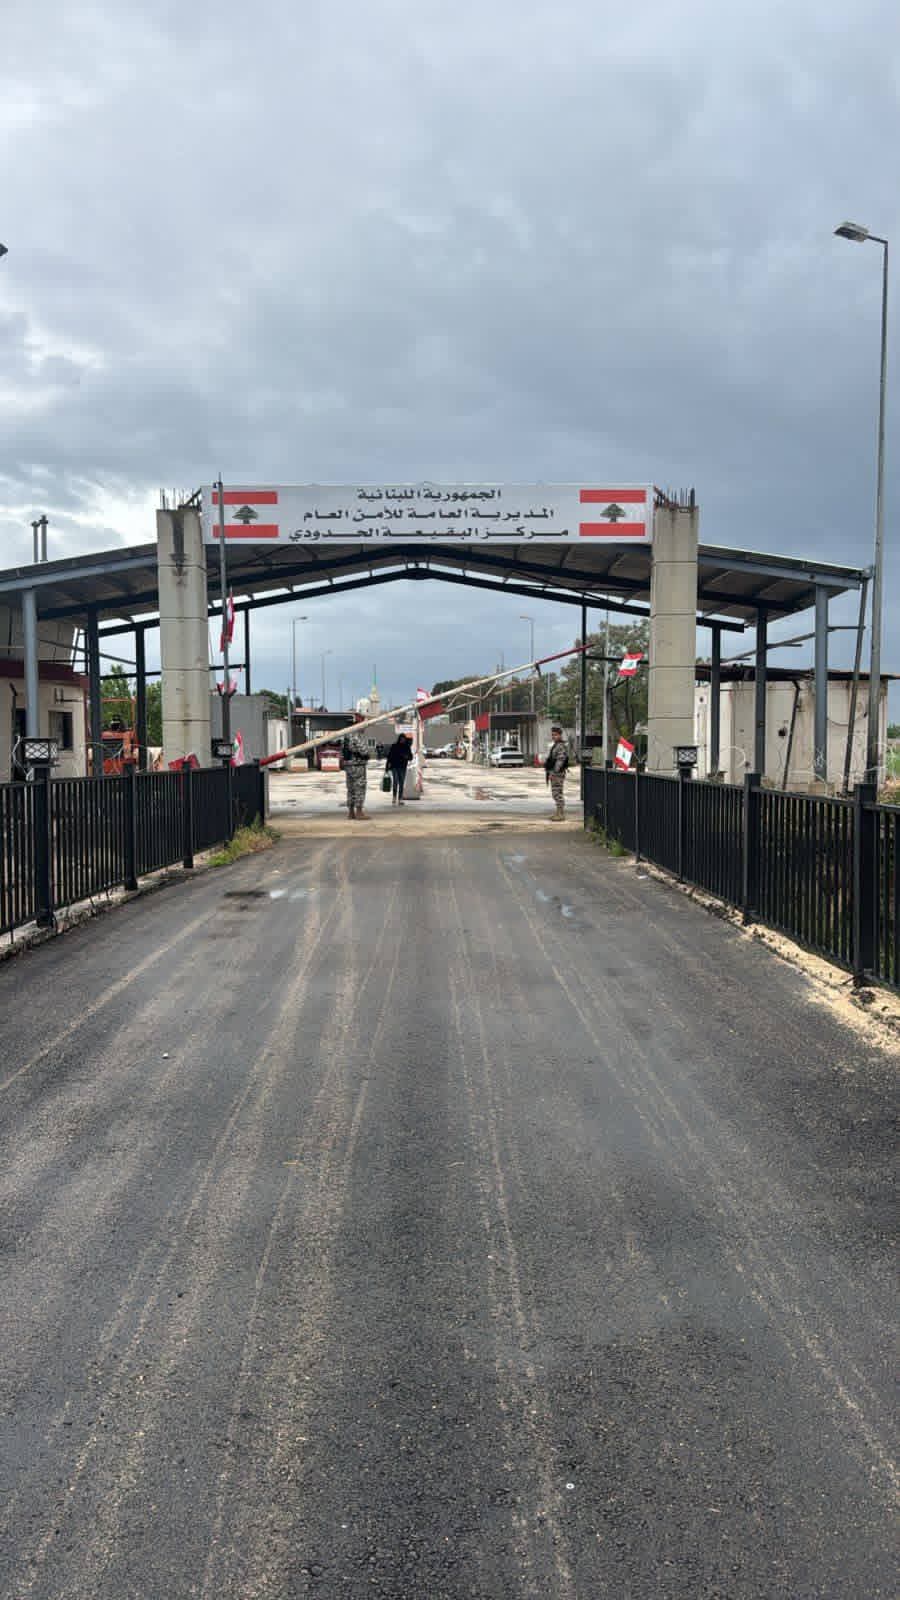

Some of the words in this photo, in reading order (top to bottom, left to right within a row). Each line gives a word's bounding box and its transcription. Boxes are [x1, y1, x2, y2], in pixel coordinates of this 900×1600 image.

[356, 488, 421, 502] اللبنانية
[422, 488, 502, 502] الجمهورية
[303, 508, 349, 522] العام
[407, 507, 468, 520] العامة
[471, 507, 554, 522] المديرية
[288, 527, 379, 542] الحدودي
[382, 526, 479, 540] البقيعة
[481, 526, 569, 540] مركز
